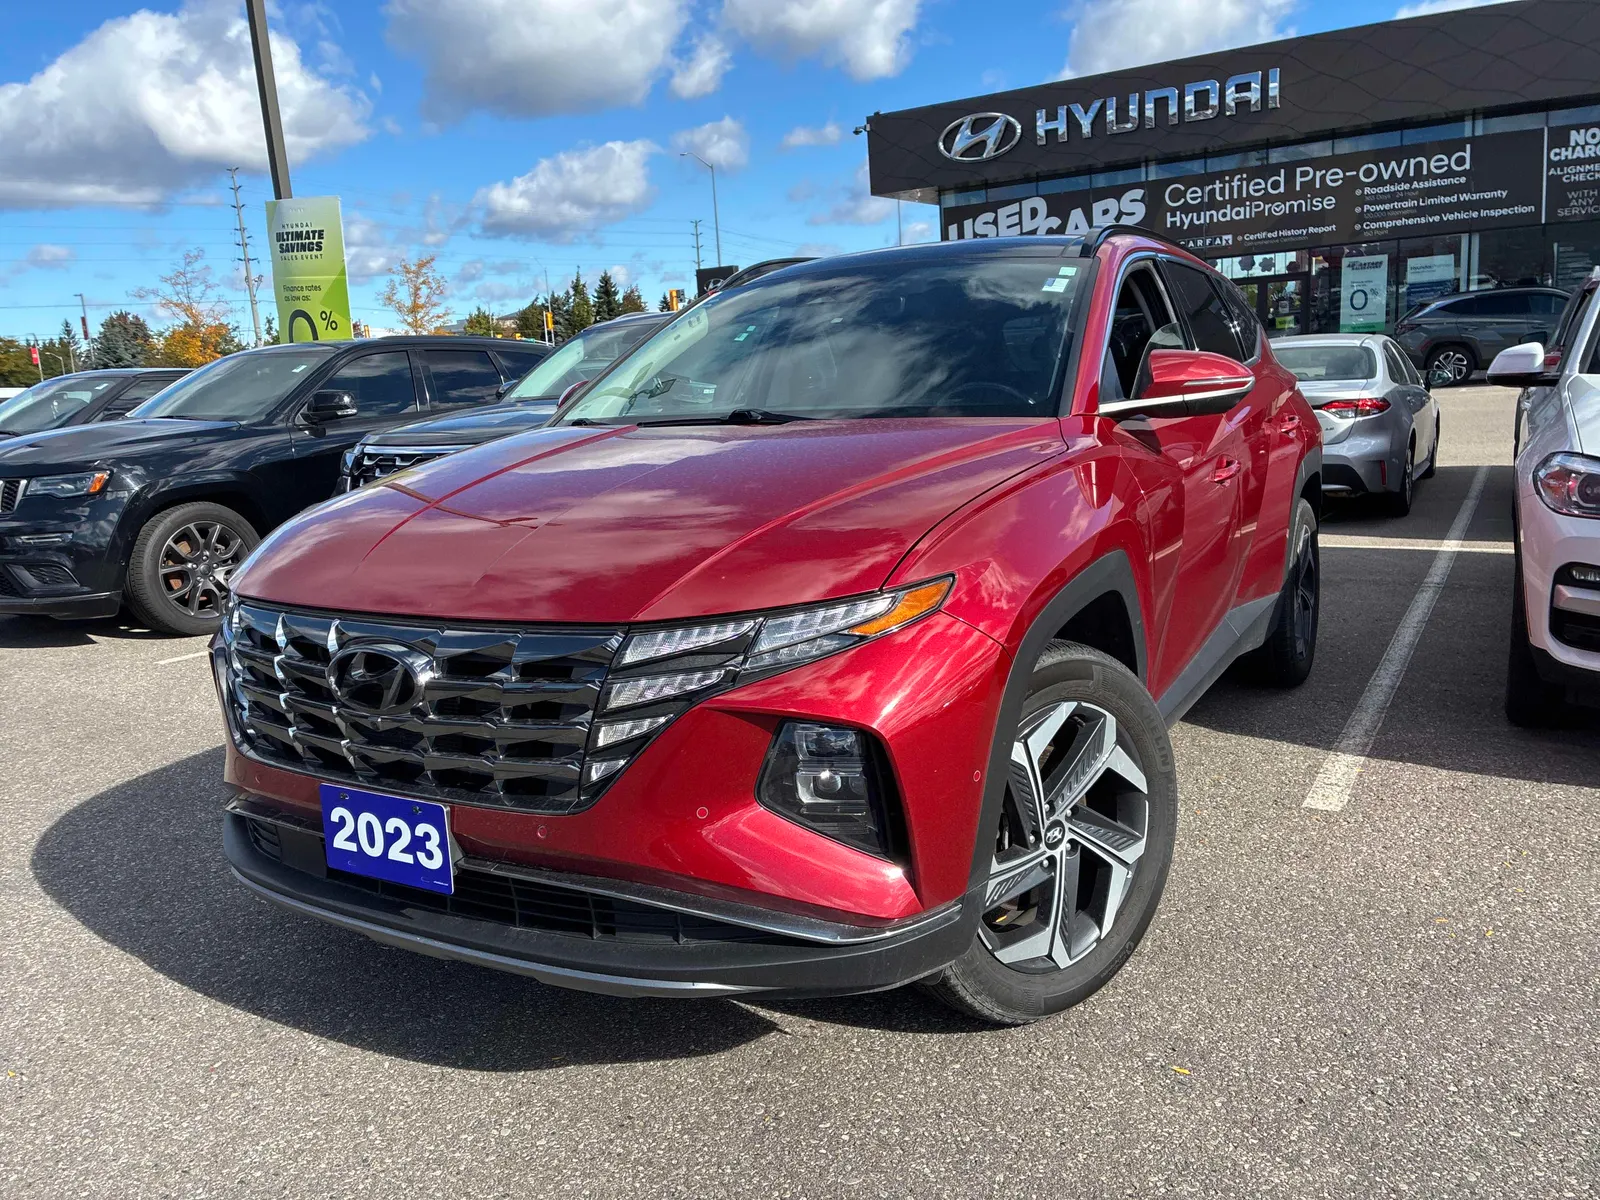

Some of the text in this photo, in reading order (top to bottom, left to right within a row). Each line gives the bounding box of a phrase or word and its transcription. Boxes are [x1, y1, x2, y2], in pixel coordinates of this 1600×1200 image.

[1036, 67, 1280, 146] HYUNDAI
[1570, 128, 1600, 146] NO
[1164, 143, 1471, 207] Certified Pre-owned
[1363, 175, 1467, 196] Roadside Assistance
[1566, 188, 1598, 200] WITH
[1363, 189, 1508, 213] Powertrain Limited Warranty
[1570, 198, 1595, 207] ANY
[1363, 204, 1535, 230] Comprehensive Vehicle Inspection
[275, 229, 325, 243] ULTIMATE
[1243, 224, 1337, 241] Certified History Report
[279, 241, 323, 254] SAVINGS
[282, 284, 321, 293] Finance rates
[330, 806, 443, 870] 2023
